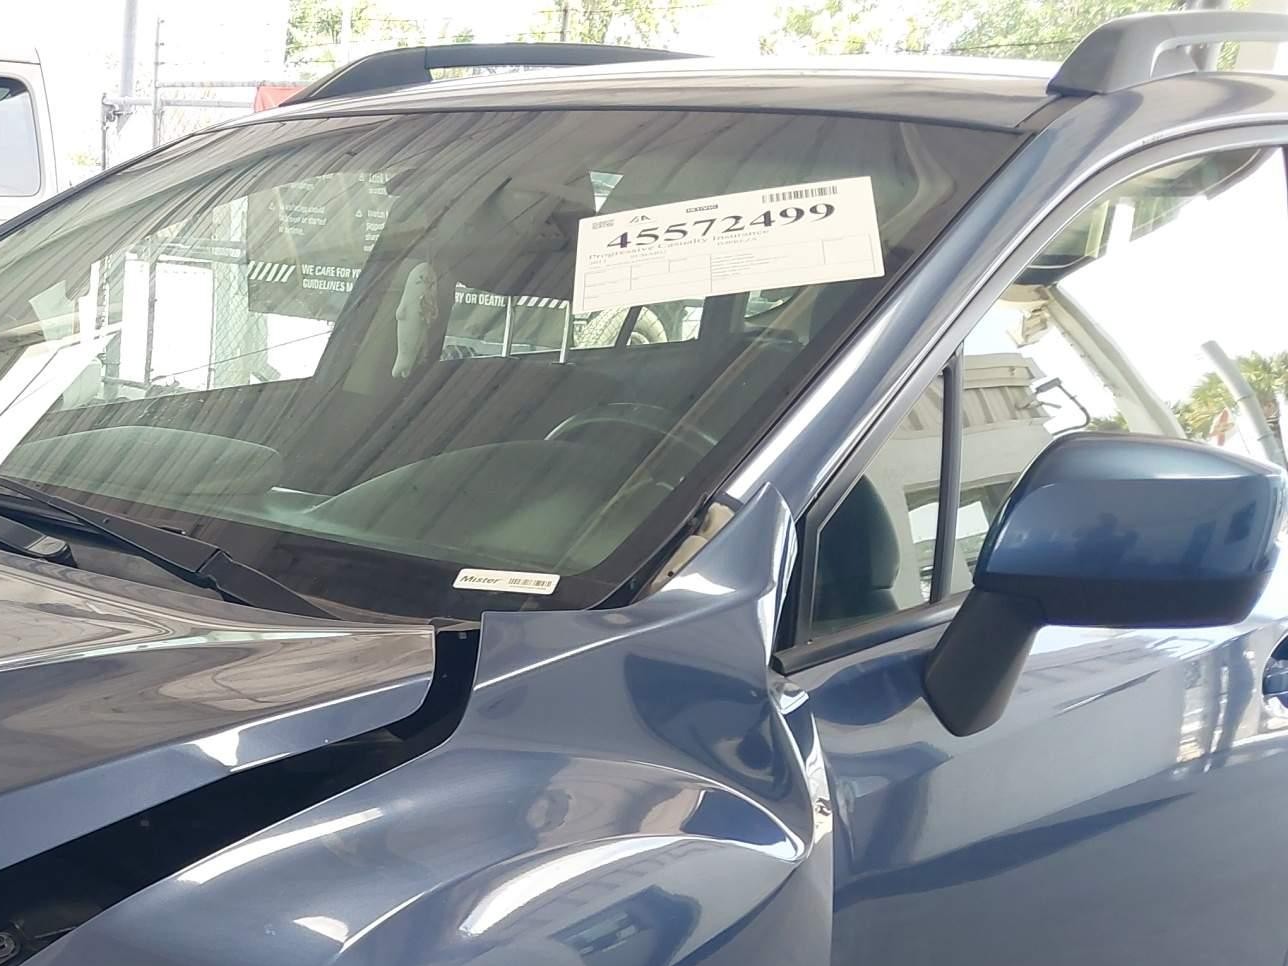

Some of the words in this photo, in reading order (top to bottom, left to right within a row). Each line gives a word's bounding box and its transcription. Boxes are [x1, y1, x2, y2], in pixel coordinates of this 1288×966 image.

[605, 203, 835, 249] 45572499
[302, 263, 314, 275] WE
[315, 265, 336, 277] CARE
[336, 267, 351, 278] FOR
[302, 278, 345, 292] GUIDELINES
[465, 293, 477, 304] OR
[460, 575, 500, 584] Mister
